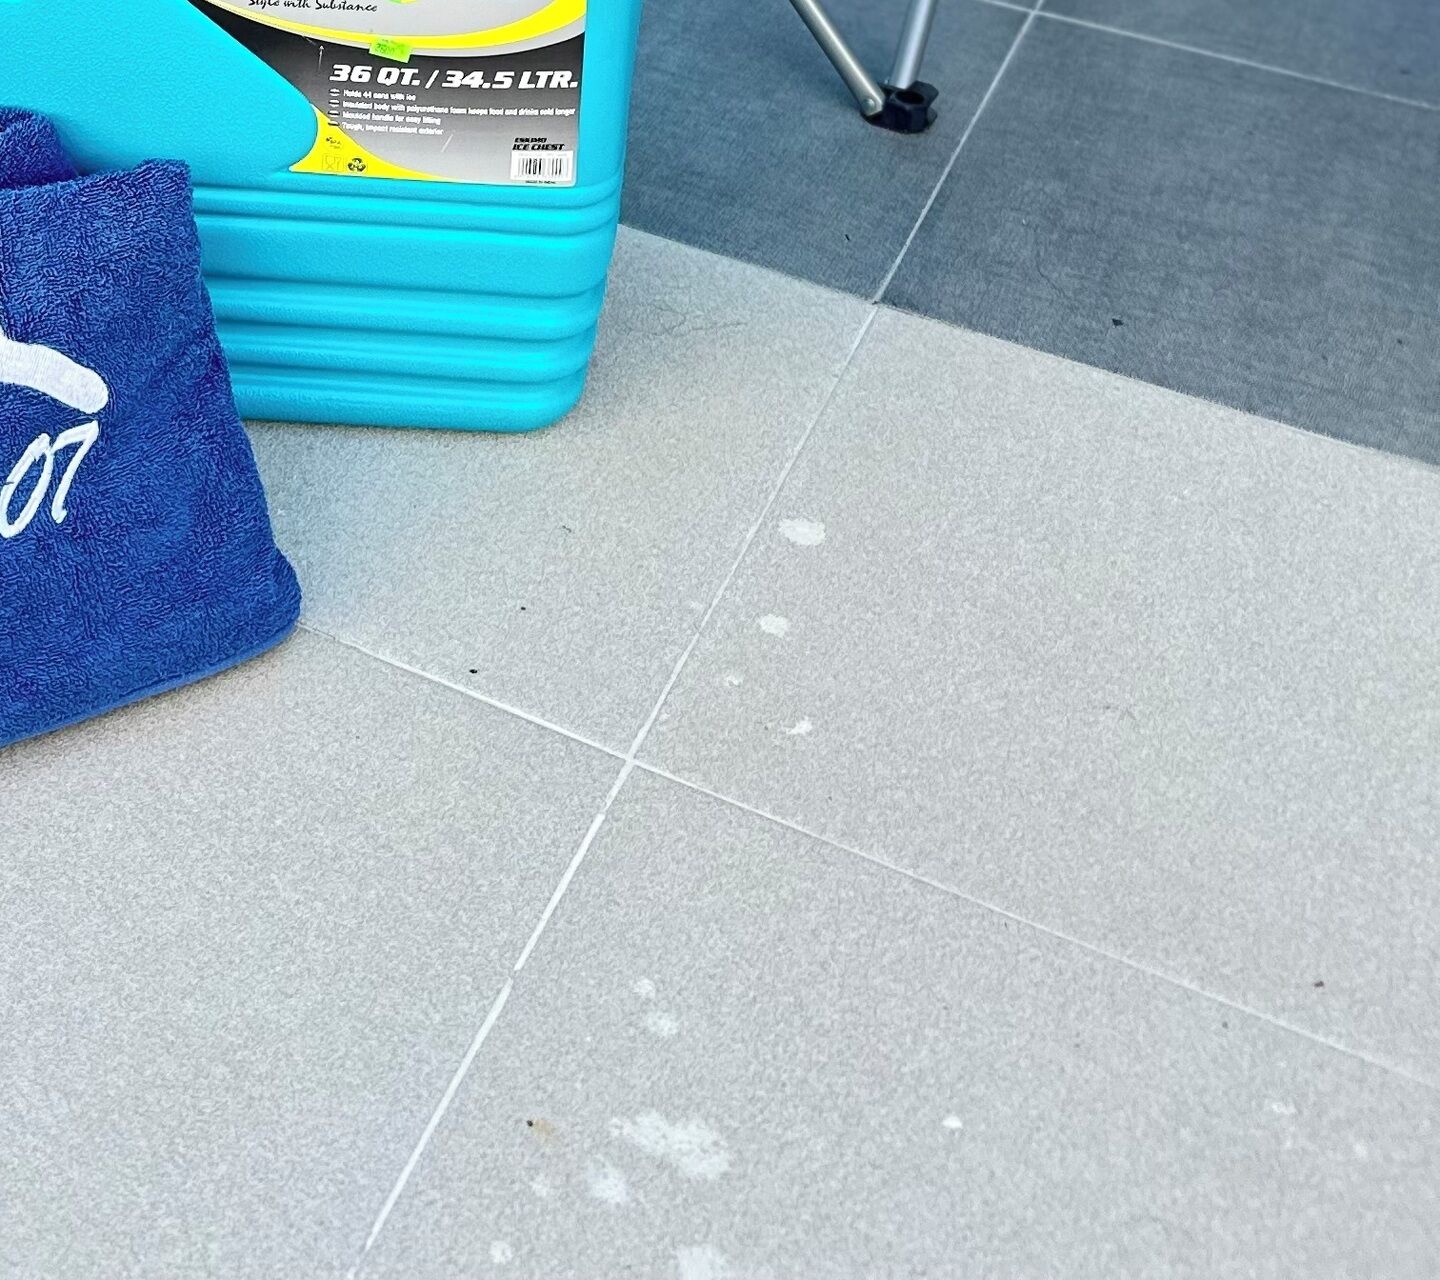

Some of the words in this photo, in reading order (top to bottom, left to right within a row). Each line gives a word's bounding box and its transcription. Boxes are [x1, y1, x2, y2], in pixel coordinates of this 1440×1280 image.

[329, 64, 372, 83] 36
[376, 67, 420, 86] QT.
[424, 69, 439, 89] /
[442, 69, 515, 89] 34.5
[517, 70, 579, 89] LTR.
[390, 92, 405, 100] with
[374, 102, 390, 111] body
[391, 103, 405, 111] with
[512, 143, 530, 151] ICE
[531, 143, 566, 151] CHEST
